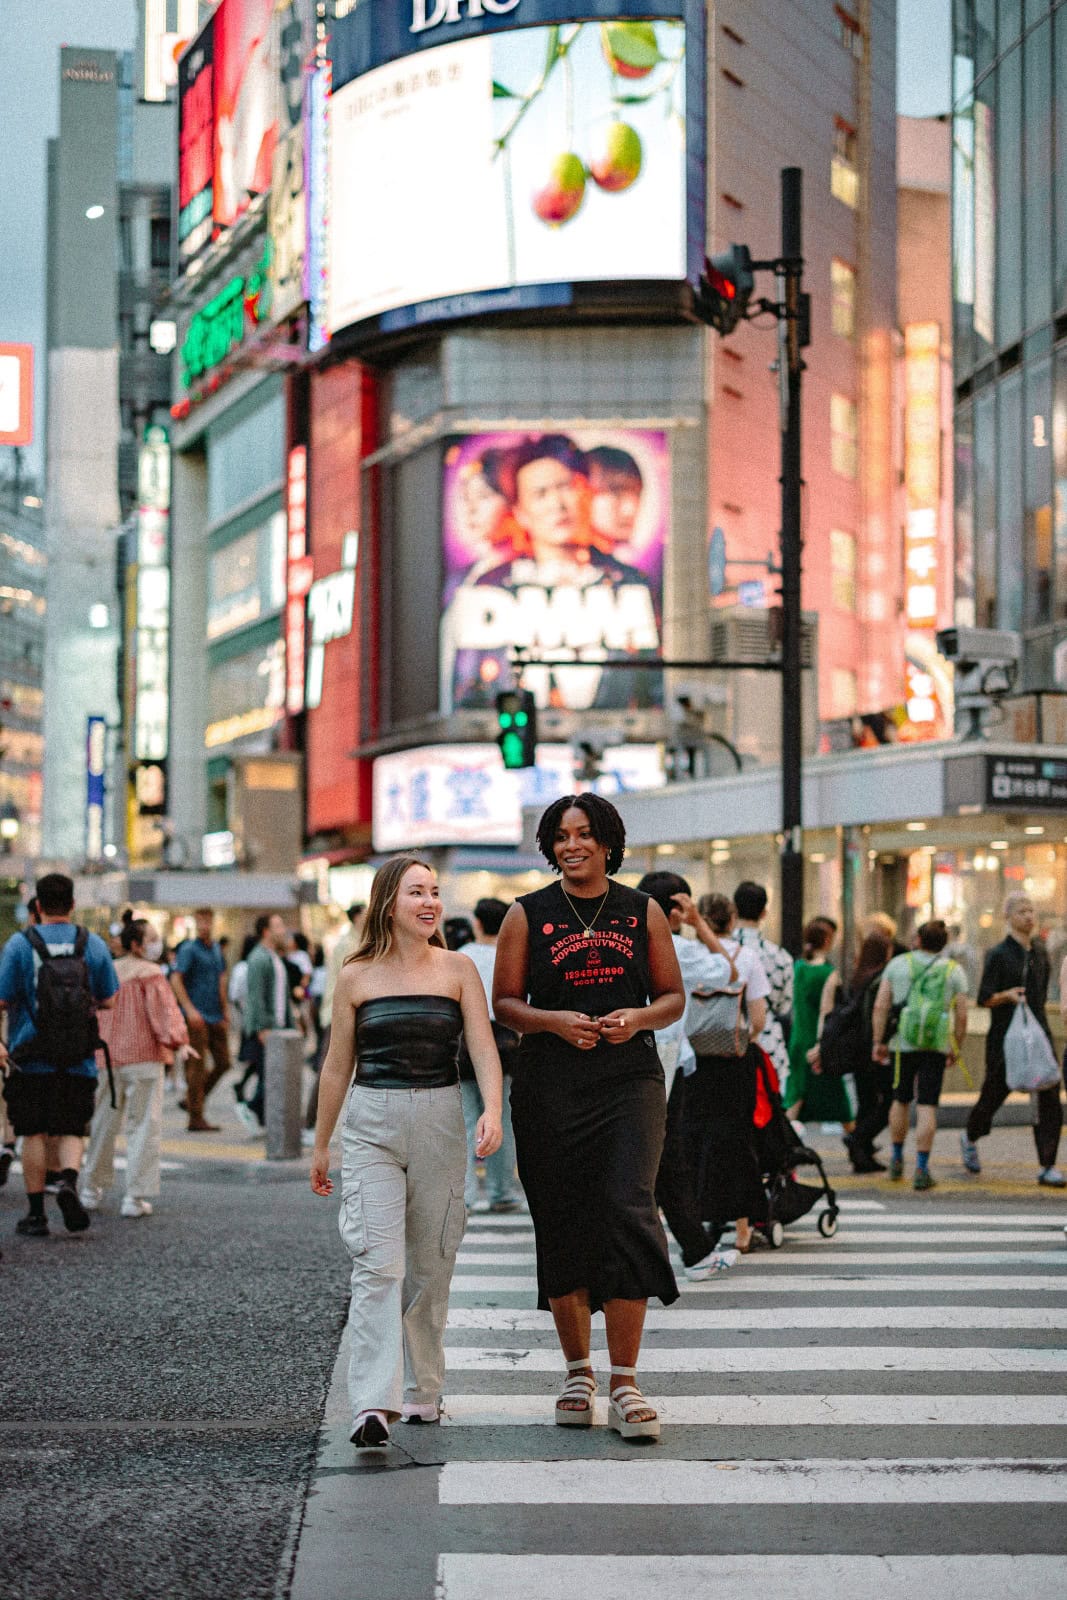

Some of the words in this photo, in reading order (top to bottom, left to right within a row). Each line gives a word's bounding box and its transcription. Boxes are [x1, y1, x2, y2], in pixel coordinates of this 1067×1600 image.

[550, 931, 633, 955] ABCDEHIJKLM
[551, 939, 634, 966] NOPQRSTUVWXYZ
[564, 967, 625, 980] 1234567890
